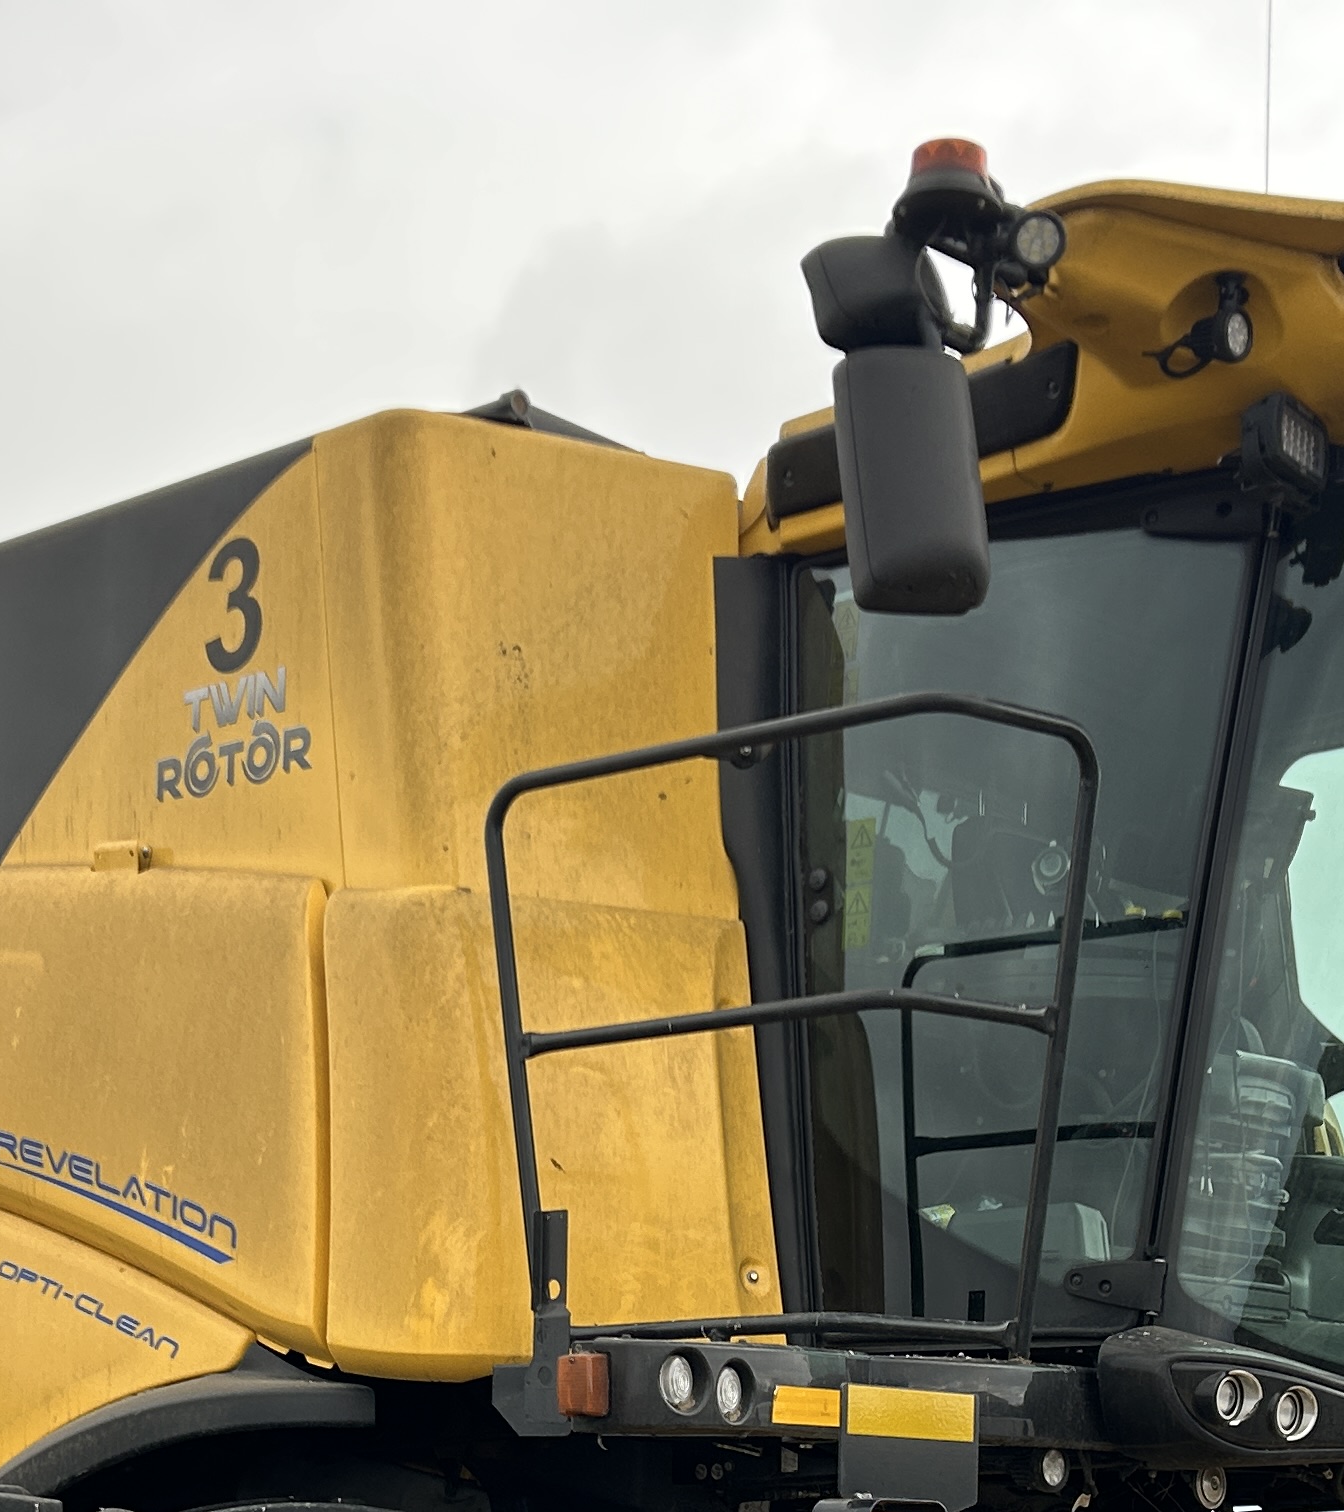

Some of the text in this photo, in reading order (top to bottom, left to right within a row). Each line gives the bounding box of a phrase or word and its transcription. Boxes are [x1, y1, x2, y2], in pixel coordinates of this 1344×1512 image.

[205, 537, 263, 675] 3
[183, 664, 287, 733] TWIN
[156, 719, 312, 803] ROTOR
